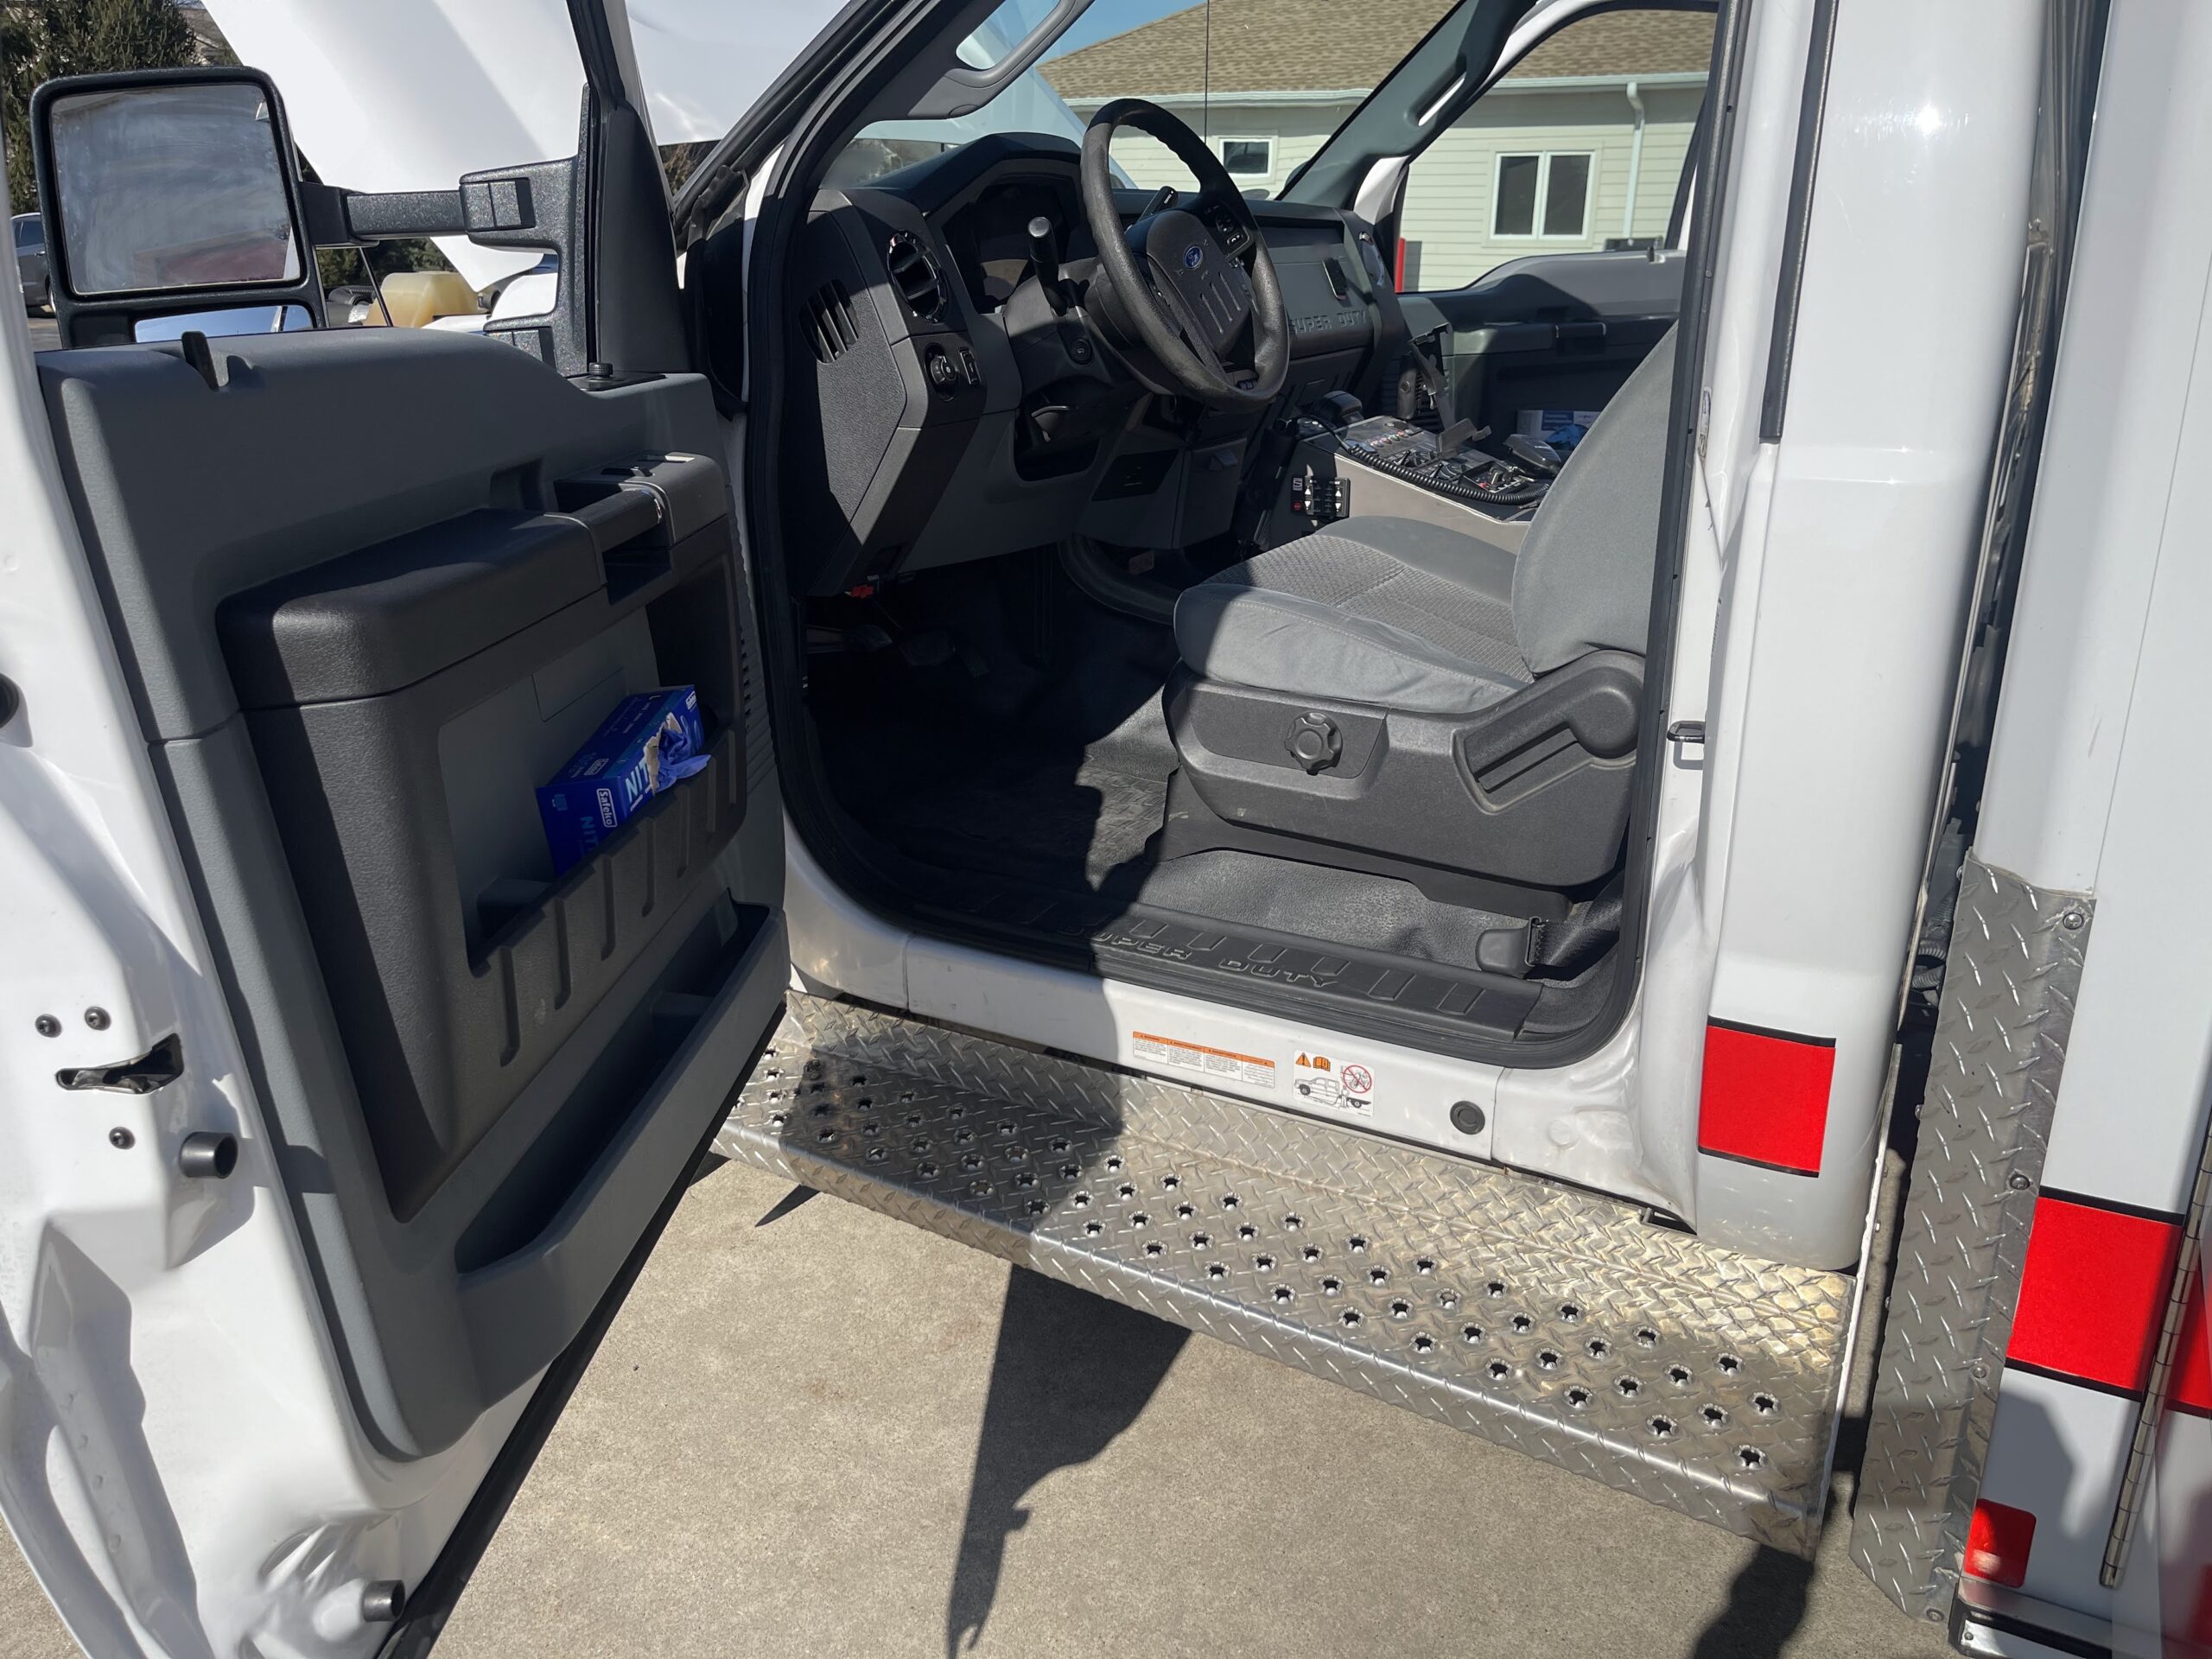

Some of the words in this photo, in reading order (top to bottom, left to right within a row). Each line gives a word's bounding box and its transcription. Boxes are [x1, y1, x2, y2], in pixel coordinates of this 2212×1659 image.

[598, 789, 615, 826] Safeko
[581, 816, 599, 851] NIT
[1058, 925, 1192, 960] UPER
[1218, 957, 1338, 988] DUTY
